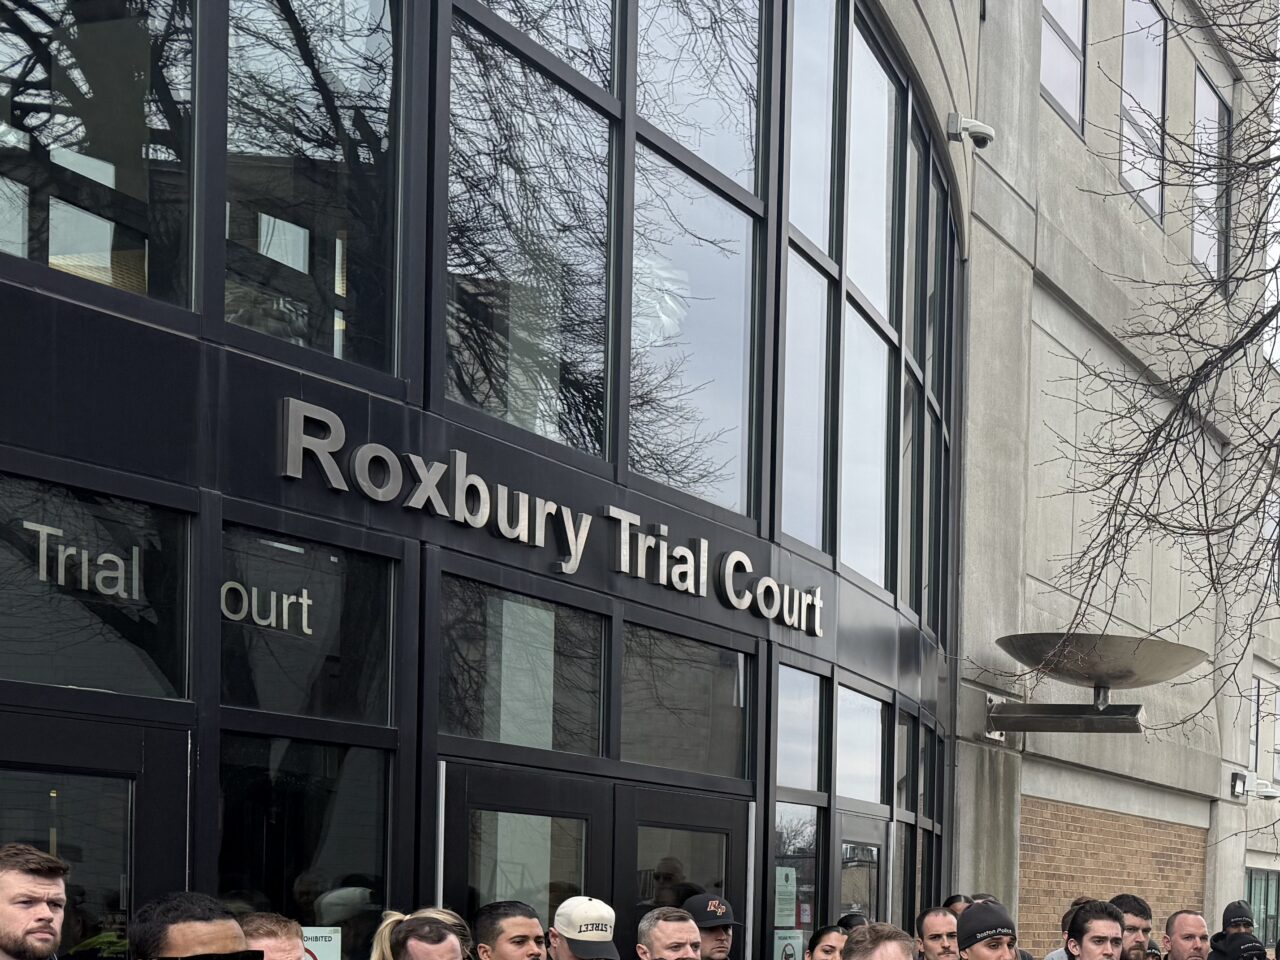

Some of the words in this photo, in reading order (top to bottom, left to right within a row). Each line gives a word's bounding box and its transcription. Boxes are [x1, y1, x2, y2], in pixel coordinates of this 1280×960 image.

[281, 397, 592, 575] Roxbury
[605, 505, 709, 597] Trial
[719, 551, 824, 638] Court
[23, 521, 140, 600] Trial
[221, 581, 313, 636] ourt
[303, 935, 333, 943] OHIBITED
[578, 922, 608, 934] STREET
